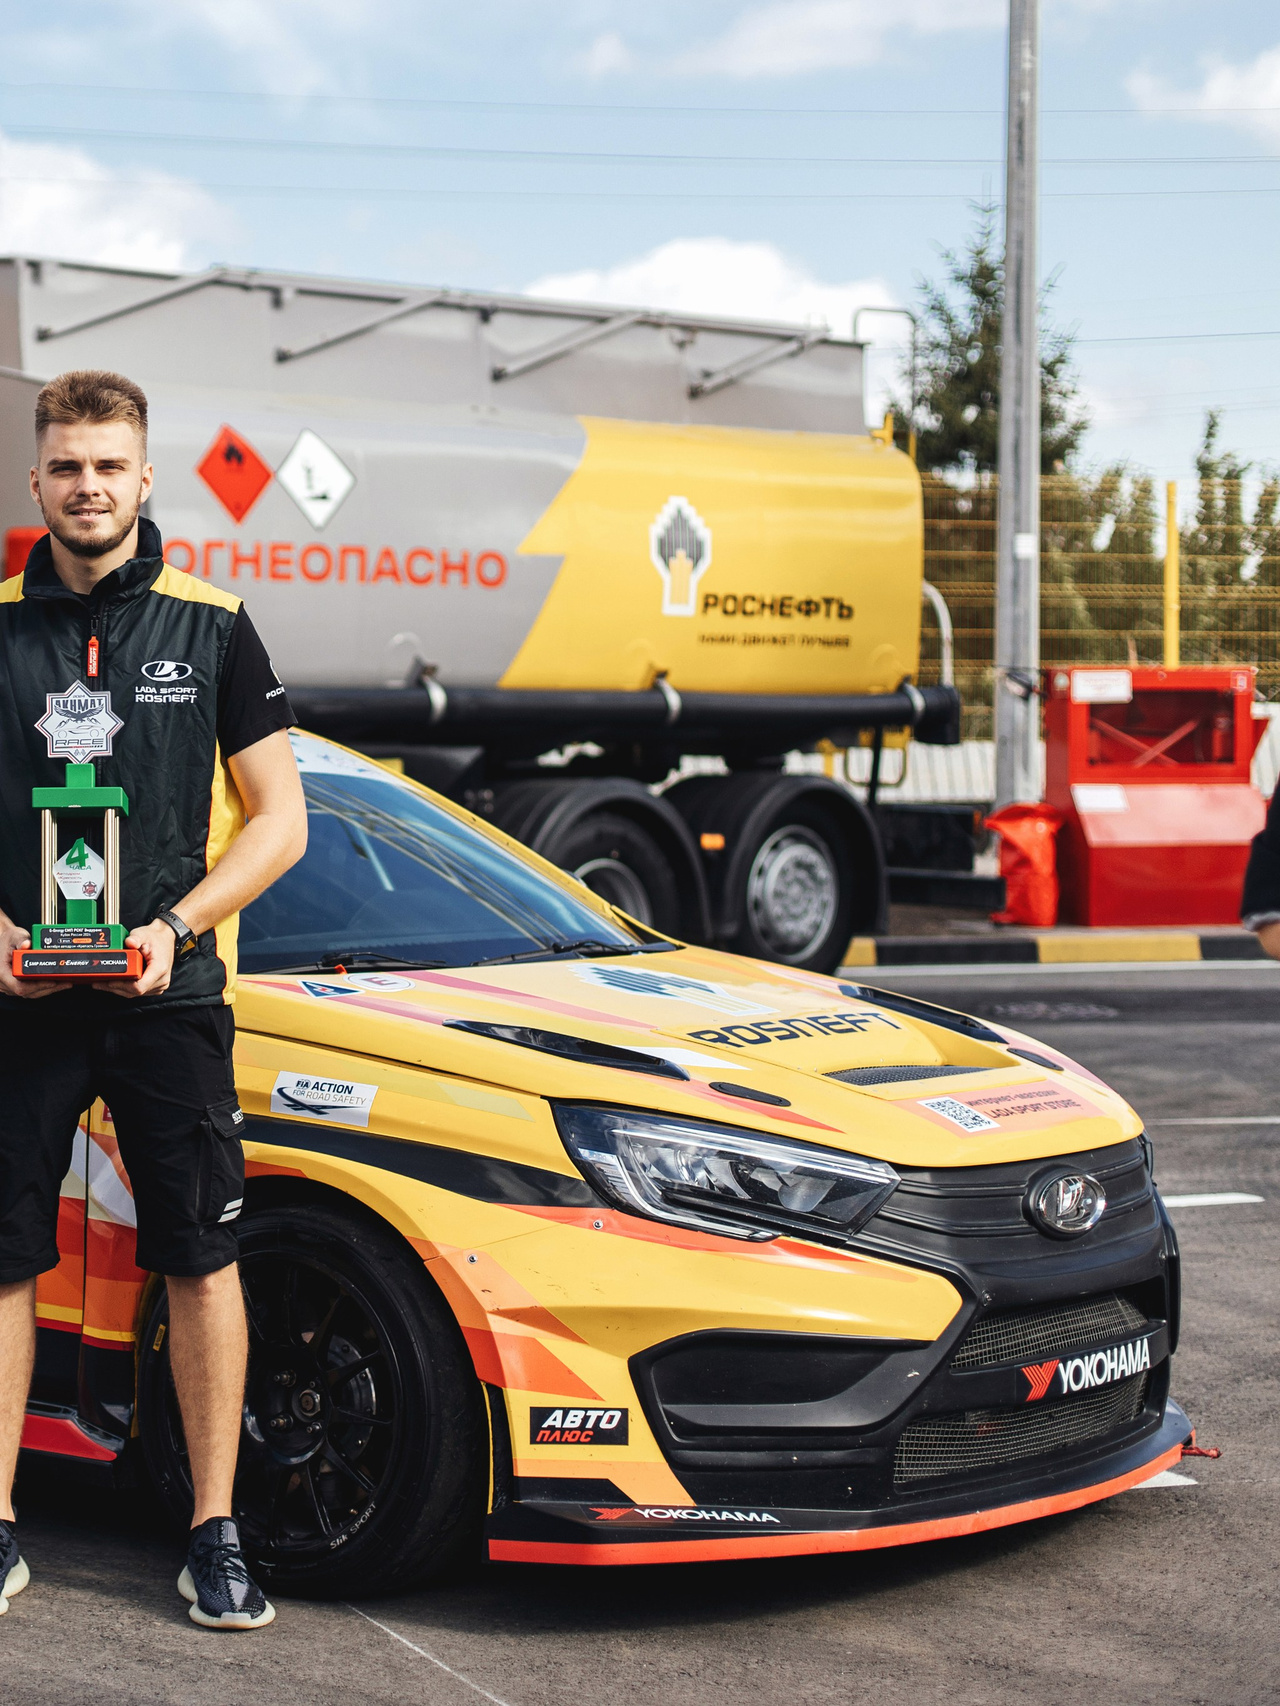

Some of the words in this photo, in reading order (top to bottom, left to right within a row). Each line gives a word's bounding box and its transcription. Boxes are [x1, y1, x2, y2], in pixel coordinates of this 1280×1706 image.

[162, 537, 509, 590] ОГНЕОПАСНО
[702, 593, 854, 619] РОСНЕФТЬ
[135, 686, 157, 694] LADA
[135, 694, 197, 703] ROSNEFT
[55, 698, 103, 712] AKHMAT
[55, 738, 104, 746] RACE
[65, 837, 89, 868] 4
[99, 932, 105, 941] 2
[686, 1012, 902, 1048] ROSNEFT
[296, 1080, 310, 1089] FIA
[311, 1081, 354, 1095] ACTION
[293, 1089, 306, 1097] FOR
[306, 1091, 331, 1102] ROAD
[332, 1094, 367, 1106] SAFETY
[983, 1106, 1015, 1119] LADA
[1010, 1102, 1048, 1115] SPORT
[1048, 1098, 1082, 1110] STORE
[1058, 1338, 1151, 1394] YOKOHAMA
[542, 1409, 622, 1430] АВТО
[536, 1430, 594, 1442] ПЛЮС
[634, 1508, 781, 1523] YOKOHAMA
[330, 1534, 348, 1549] Slik
[350, 1501, 376, 1534] SPORT
